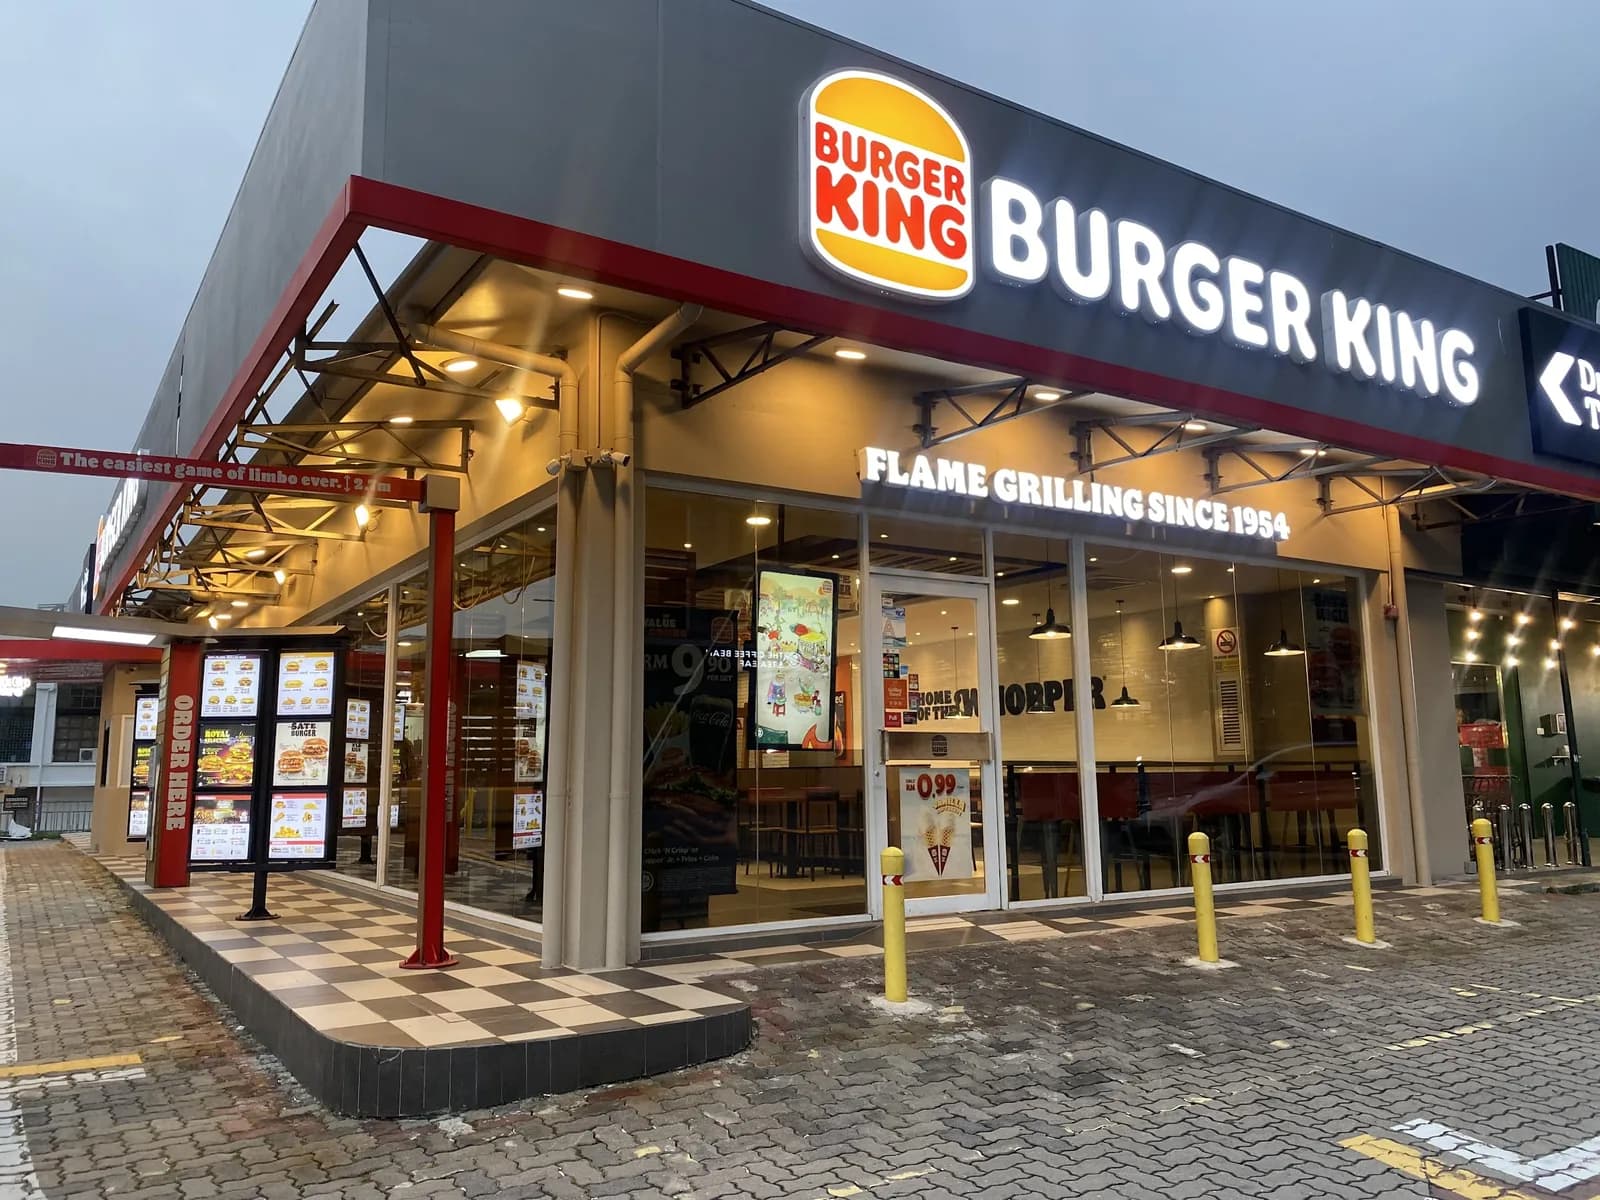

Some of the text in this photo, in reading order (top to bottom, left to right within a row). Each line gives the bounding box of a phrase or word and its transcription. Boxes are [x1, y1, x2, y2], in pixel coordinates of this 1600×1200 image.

[815, 121, 966, 205] BURGER
[816, 165, 967, 260] KING
[990, 177, 1479, 404] BURGER KING
[60, 452, 99, 469] The
[103, 457, 171, 474] easiest
[174, 463, 222, 479] game
[227, 466, 247, 480] of
[249, 468, 298, 485] limbo
[301, 476, 342, 489] ever.
[866, 446, 1291, 540] FLAME GRILLING SINCE 1954
[671, 643, 705, 695] 9
[707, 656, 731, 673] 90
[917, 706, 932, 721] OF
[918, 690, 953, 706] HOME
[290, 729, 317, 737] BURGER
[165, 694, 194, 831] ORDER HERE
[917, 773, 956, 800] 0.99
